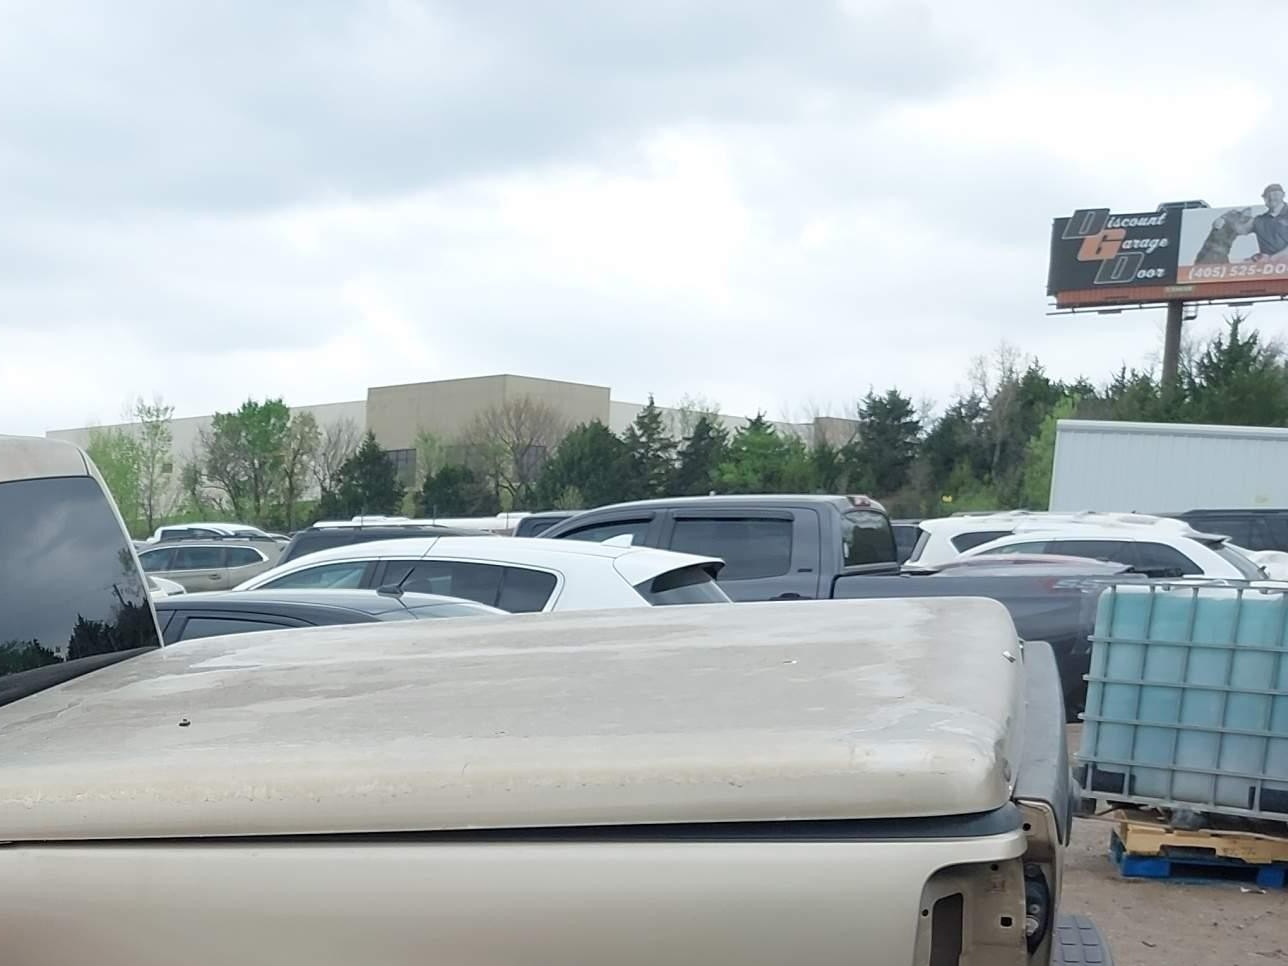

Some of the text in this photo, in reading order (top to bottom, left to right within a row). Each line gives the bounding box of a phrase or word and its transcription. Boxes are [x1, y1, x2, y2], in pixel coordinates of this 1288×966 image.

[1062, 208, 1166, 240] Discount
[1077, 229, 1169, 261] Garage
[1093, 252, 1166, 284] Door
[1188, 263, 1288, 280] (405) 525-DO
